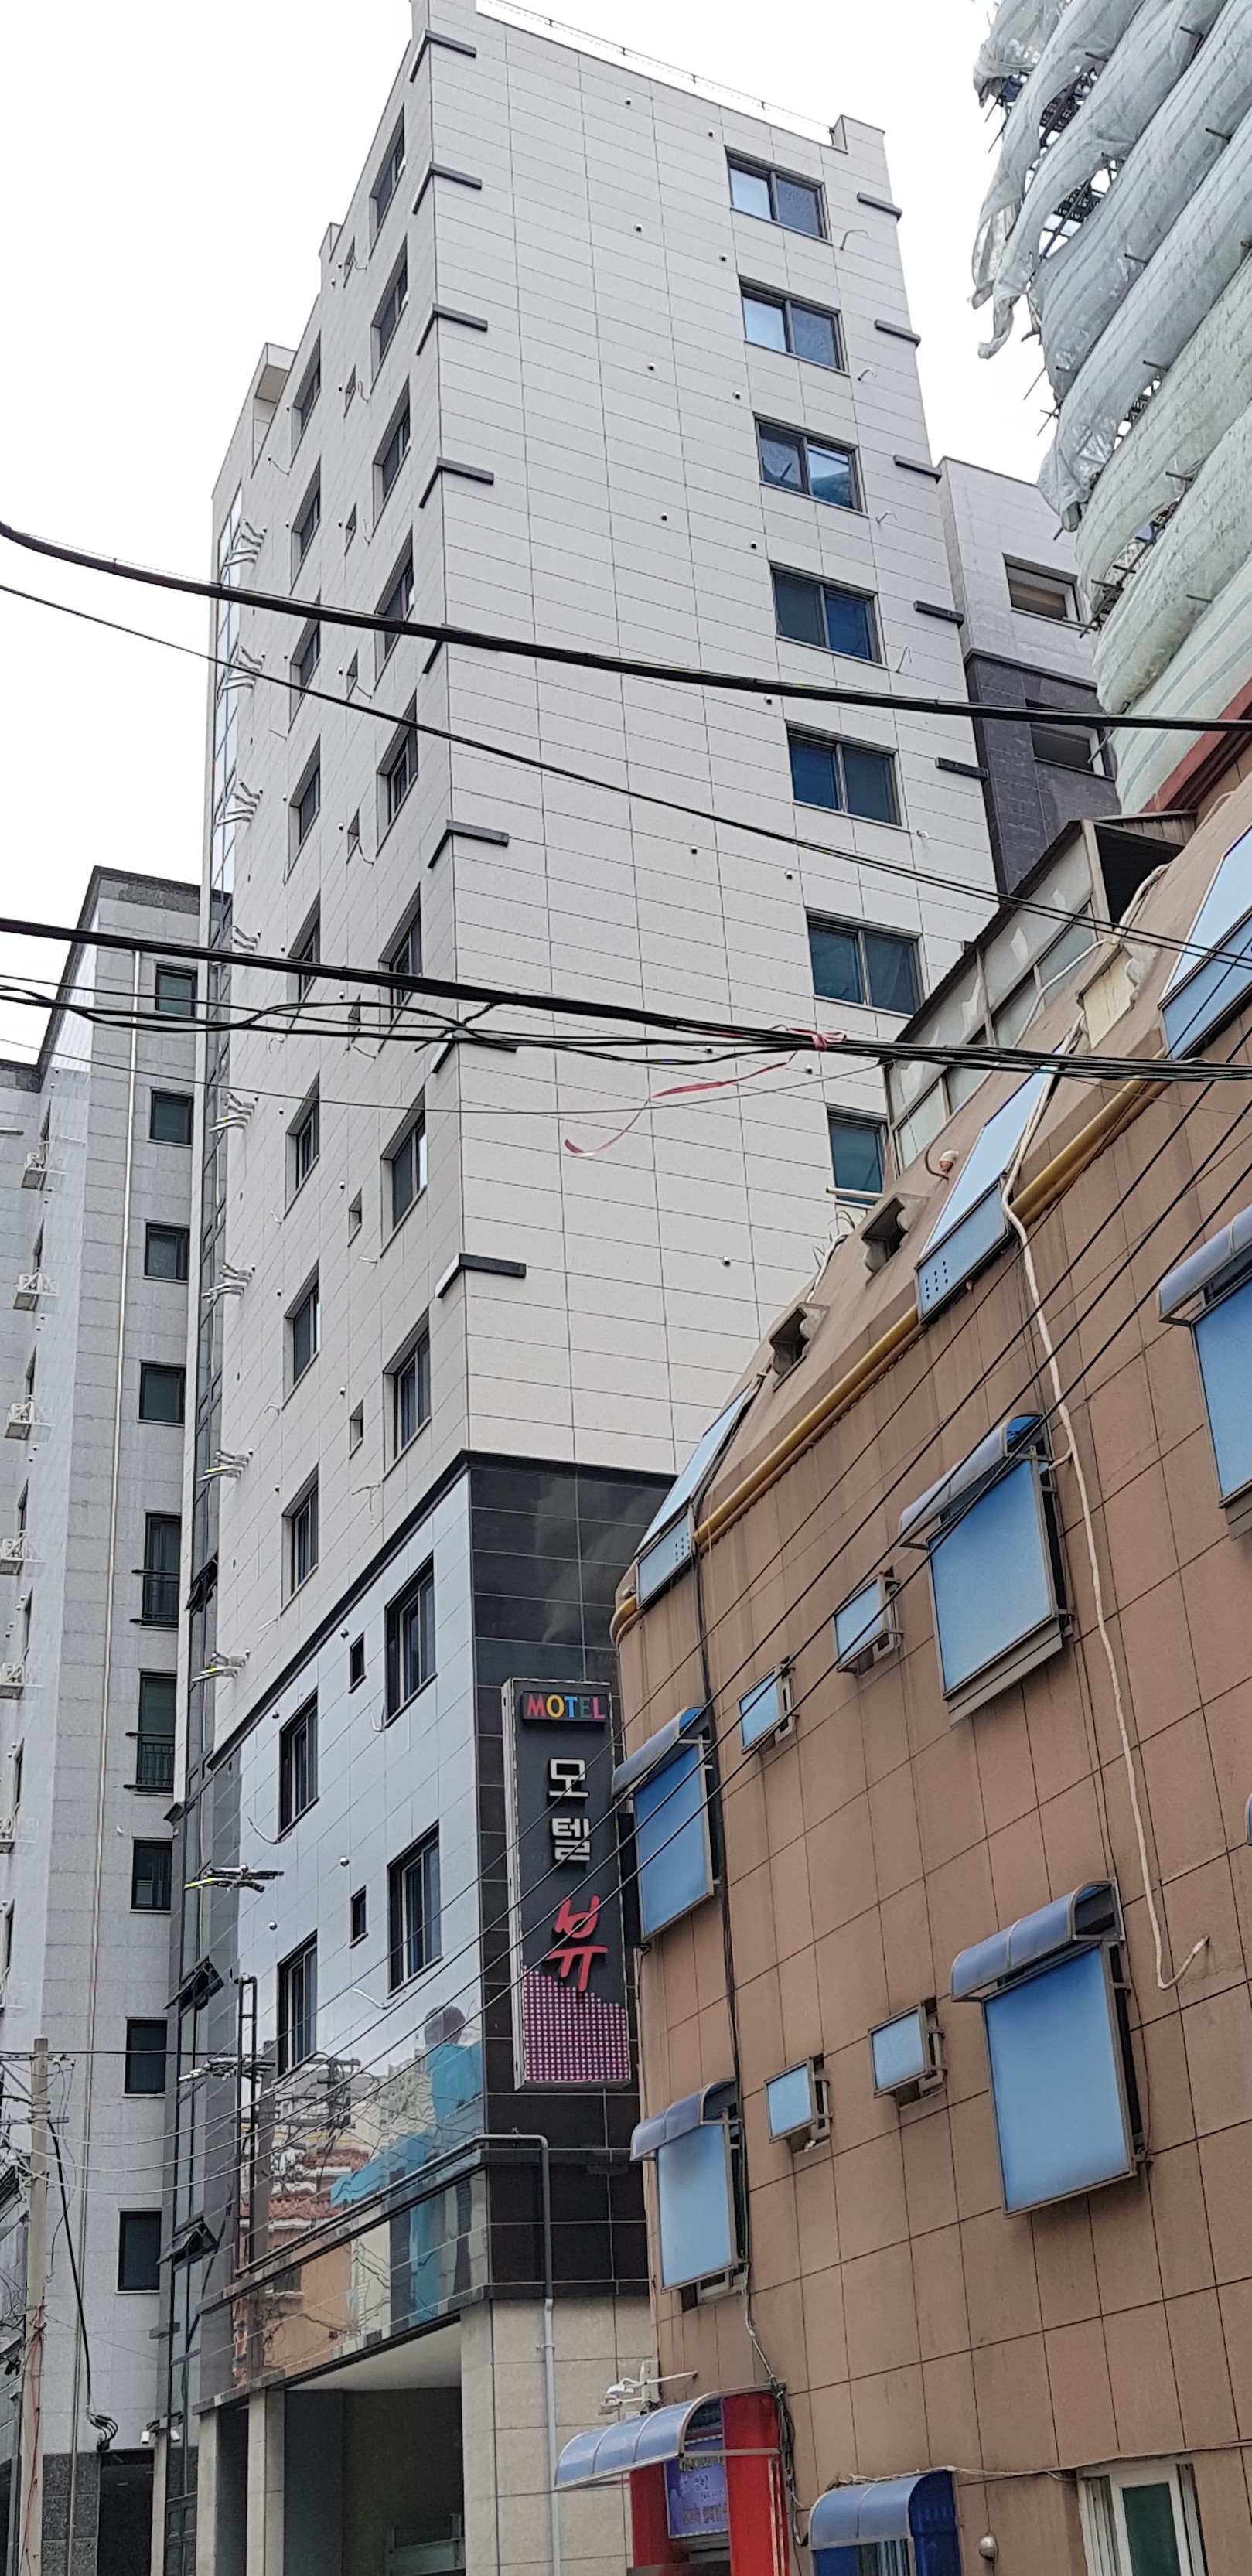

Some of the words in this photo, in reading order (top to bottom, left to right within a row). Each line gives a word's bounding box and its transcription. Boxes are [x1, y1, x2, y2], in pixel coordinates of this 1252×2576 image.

[527, 1694, 606, 1719] MOTEL
[548, 1758, 590, 1861] 모텔
[544, 1894, 609, 1992] 뷰
